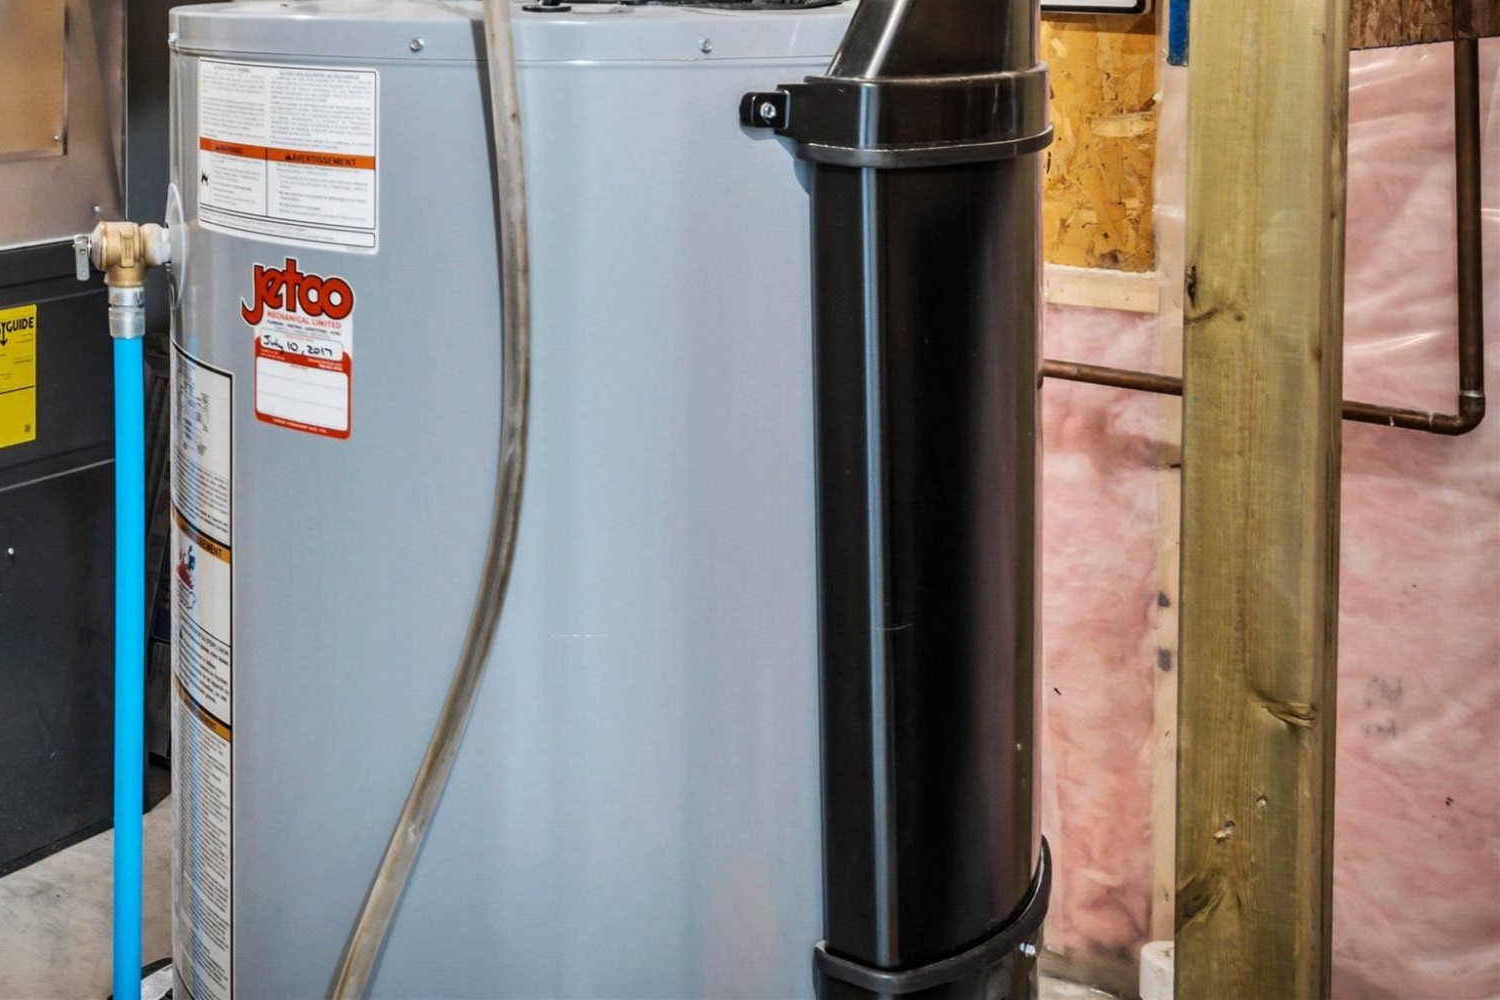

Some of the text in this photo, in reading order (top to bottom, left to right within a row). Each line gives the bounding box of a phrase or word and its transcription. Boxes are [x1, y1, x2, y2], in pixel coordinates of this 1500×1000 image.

[291, 153, 357, 166] AVERTISSEMENT
[266, 310, 341, 330] MECHANICAL LIMITED
[263, 334, 284, 354] July
[307, 344, 333, 357] 2017
